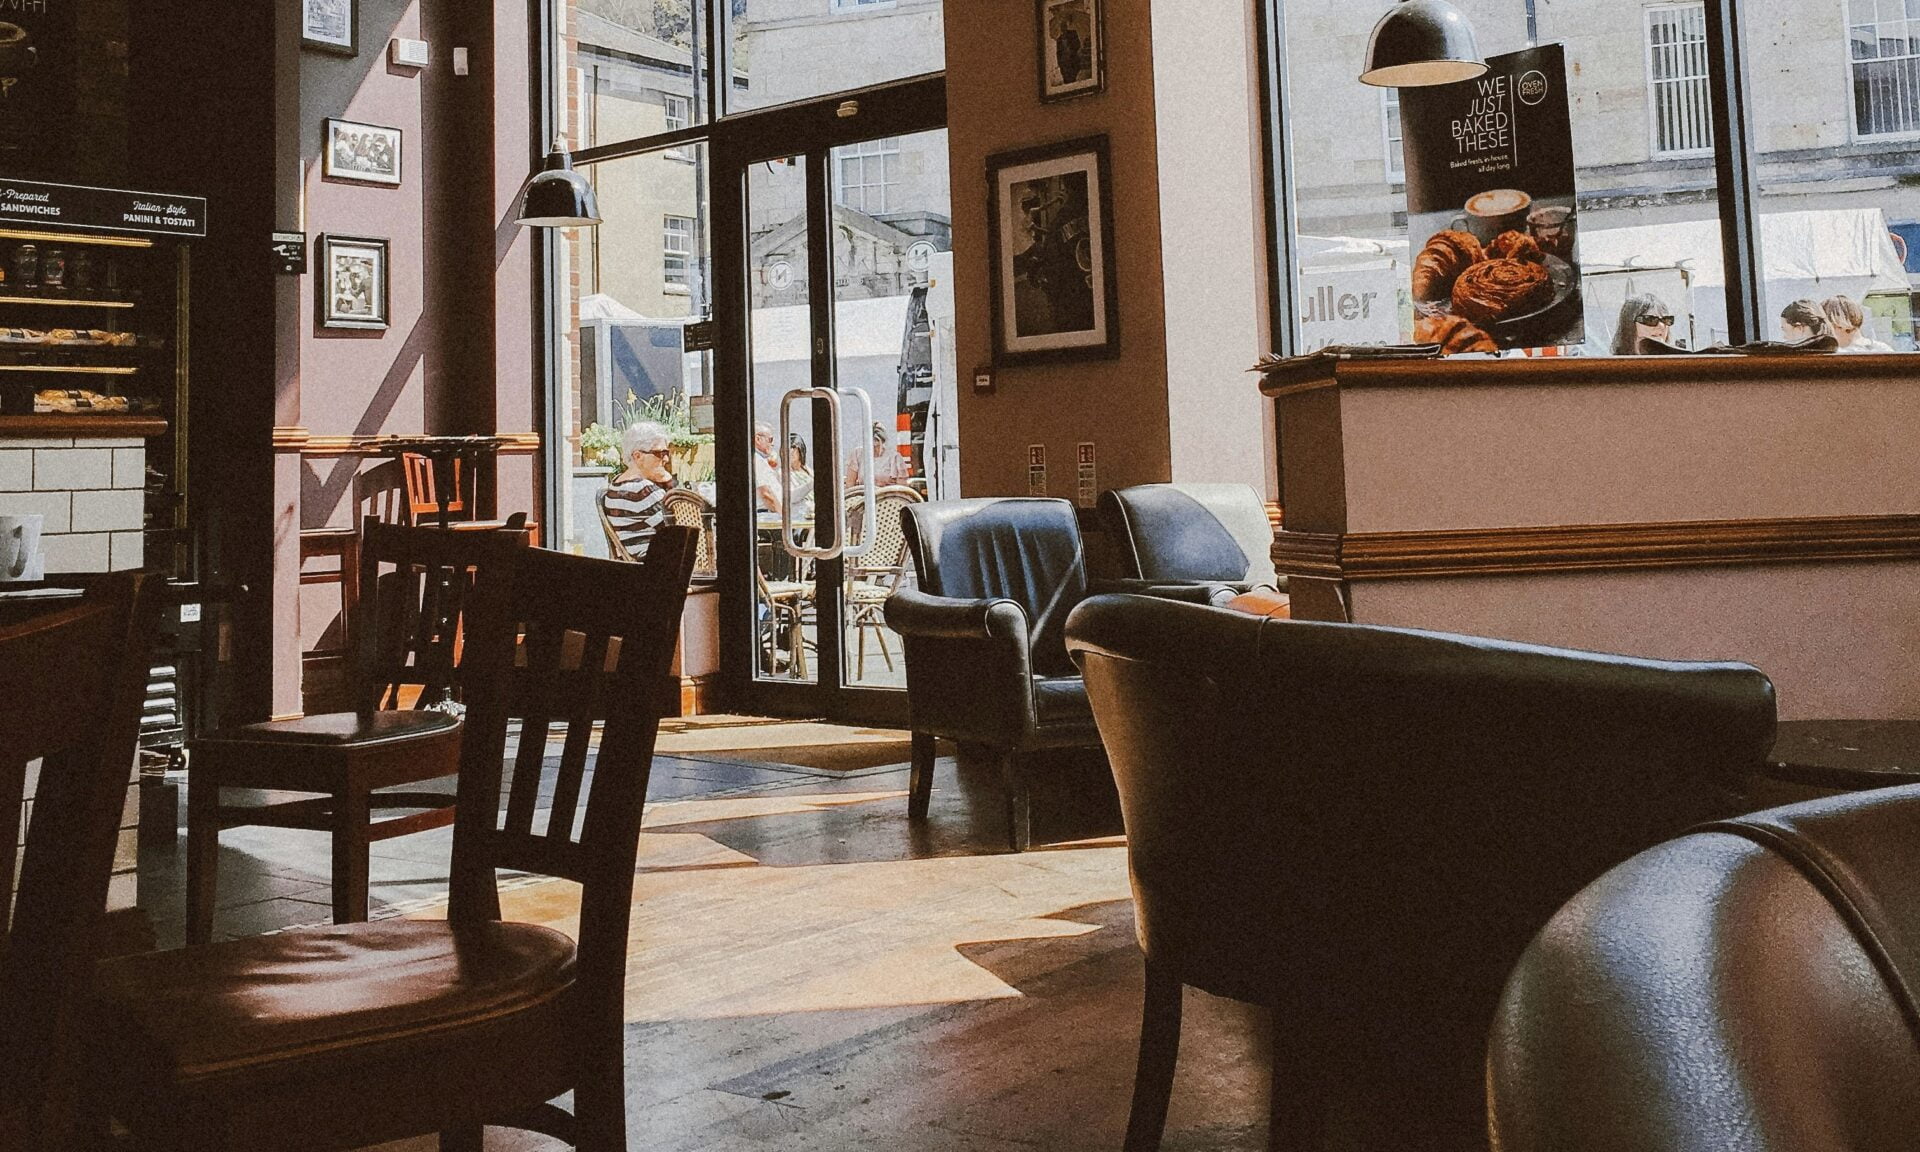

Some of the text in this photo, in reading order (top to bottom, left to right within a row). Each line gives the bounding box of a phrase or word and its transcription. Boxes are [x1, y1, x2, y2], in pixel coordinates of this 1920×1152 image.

[1477, 76, 1506, 96] WE
[1521, 79, 1543, 90] OVEN
[1521, 87, 1544, 96] FRESH
[1466, 93, 1506, 117] JUST
[1451, 111, 1508, 138] BAKED
[1455, 128, 1509, 154] THESE
[1450, 160, 1468, 169] Baked
[1485, 164, 1496, 173] day
[1496, 162, 1510, 170] long
[0, 202, 61, 216] SANDWICHES
[133, 200, 188, 216] Italian-Style
[123, 213, 196, 227] PANINI & TOSTATI
